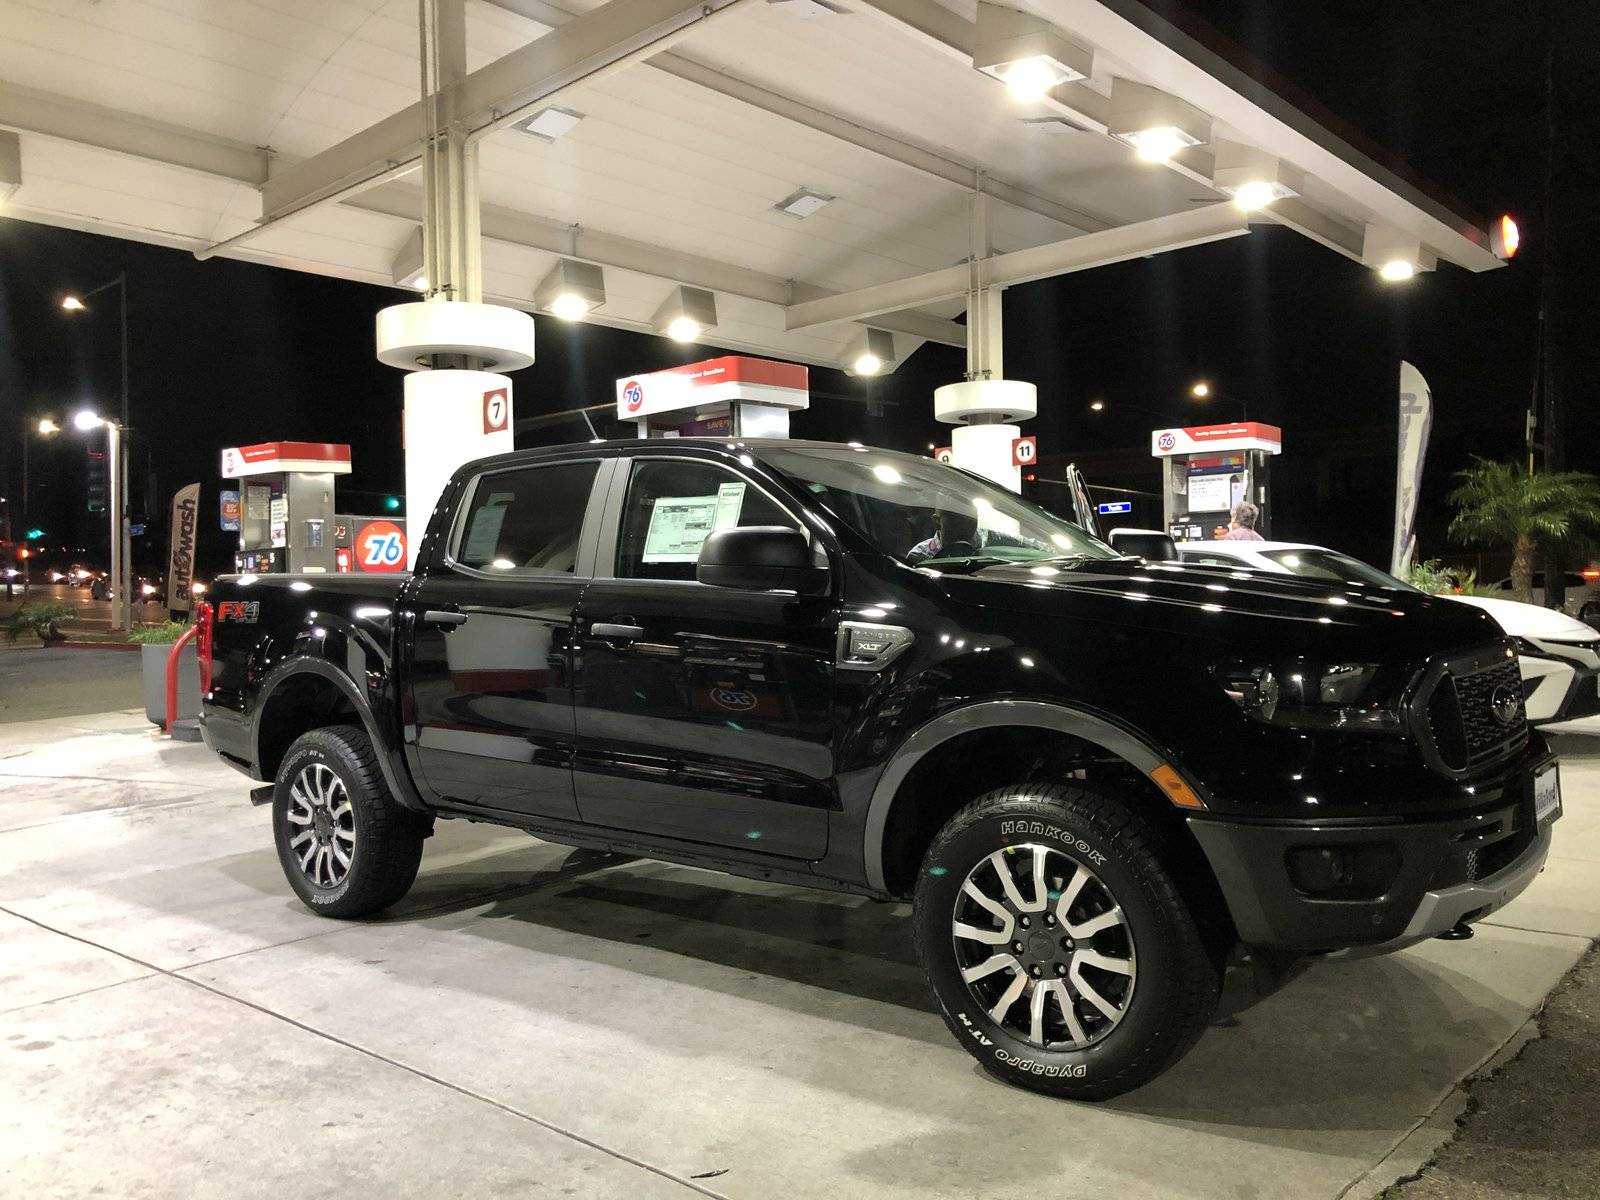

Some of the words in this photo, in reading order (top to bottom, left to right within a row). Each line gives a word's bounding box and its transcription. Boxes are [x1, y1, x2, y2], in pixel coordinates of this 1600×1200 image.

[625, 387, 641, 403] 76
[492, 401, 501, 419] 7
[1019, 445, 1030, 457] 11
[367, 533, 402, 564] 76
[218, 601, 260, 622] FX4
[858, 642, 881, 651] XLT
[994, 1048, 1087, 1078] Dynapro
